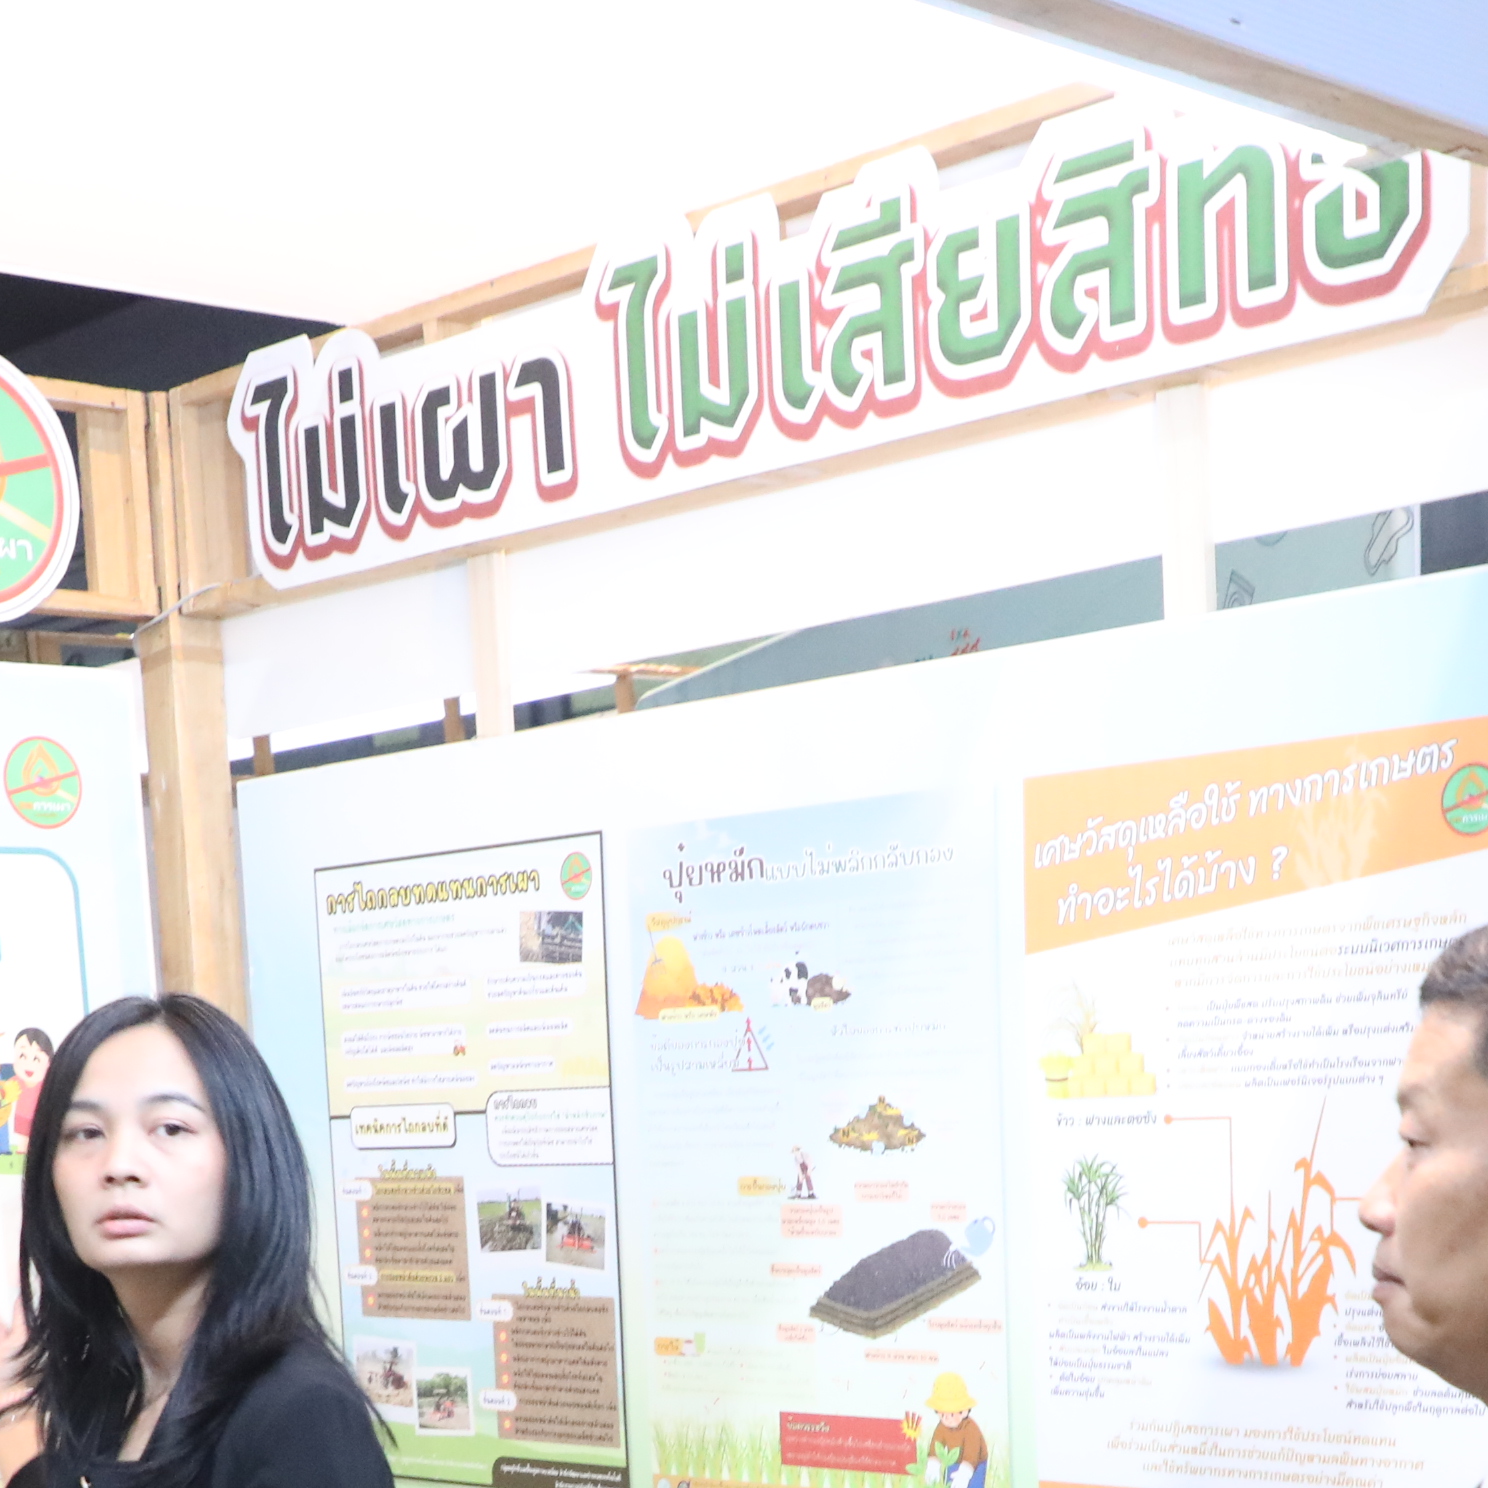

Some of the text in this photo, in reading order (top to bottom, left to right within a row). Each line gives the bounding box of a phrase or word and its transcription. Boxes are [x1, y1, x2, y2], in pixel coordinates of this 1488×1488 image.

[244, 354, 574, 566] ไม่เผา
[1032, 737, 1459, 872] เศษวัสดุเหลือใช้ ทางการเกษตร
[325, 868, 541, 917] การไถกลบทดแทนการเผา
[662, 840, 955, 904] ปุ๋ยหมักแบบไม่พลิกกลับกอง
[1056, 846, 1290, 927] ทำอะไรได้บ้าง ?
[1173, 959, 1435, 989] หากมีการจัดการและการใช้ประโยชน์อย่างเหม
[354, 1110, 449, 1135] เทคนิคการไถกลบที่ดี
[1055, 1112, 1077, 1128] ข้าว
[1083, 1110, 1158, 1128] ฟางและตอซัง
[1074, 1276, 1098, 1293] อ้อย
[1107, 1277, 1122, 1293] ใบ
